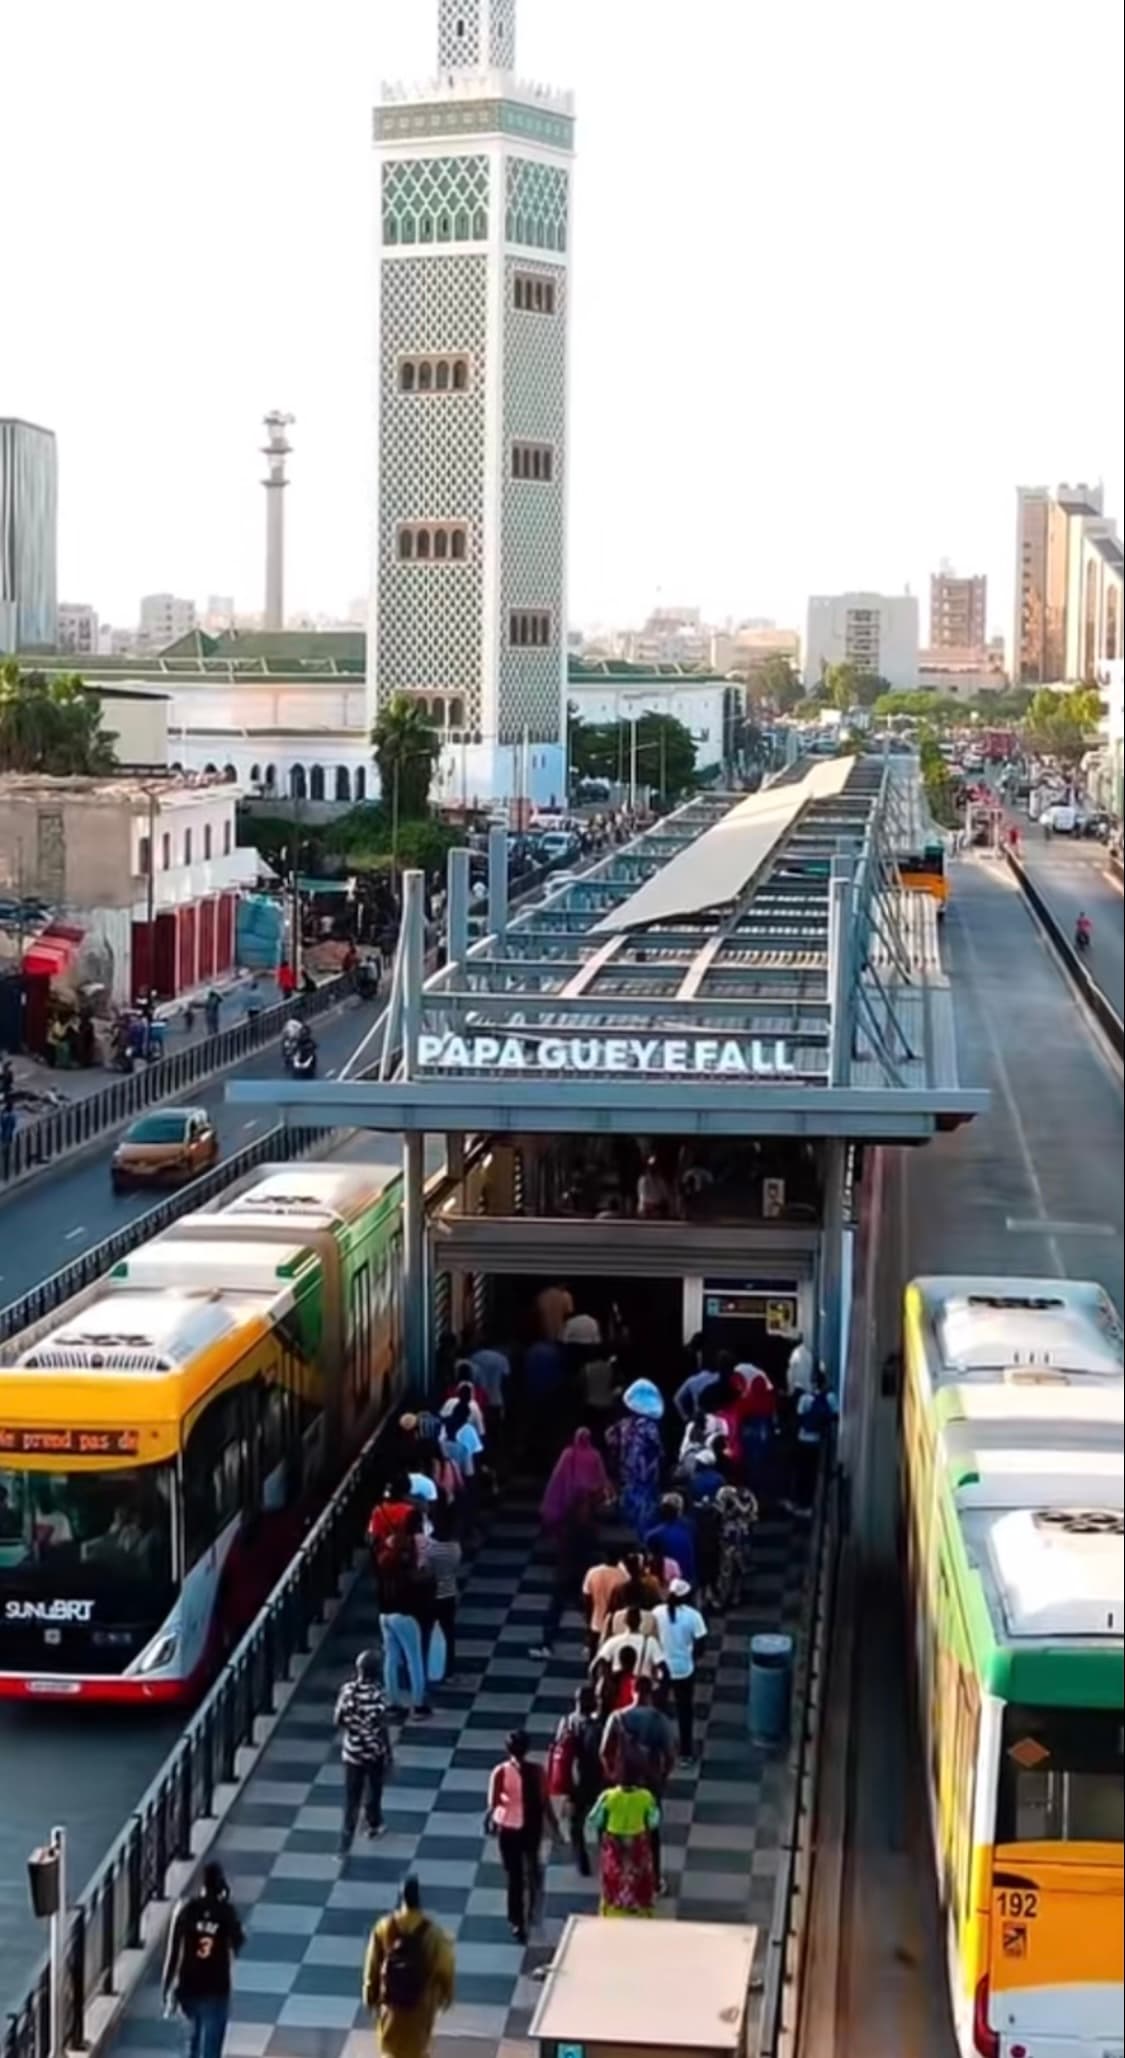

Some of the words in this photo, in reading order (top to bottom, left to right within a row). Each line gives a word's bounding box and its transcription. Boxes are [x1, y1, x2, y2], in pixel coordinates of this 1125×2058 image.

[417, 1034, 526, 1067] PAPA
[537, 1038, 688, 1071] GUEYE
[694, 1040, 796, 1073] FALL
[23, 1430, 72, 1450] prend
[79, 1434, 109, 1451] pas
[997, 1892, 1037, 1918] 192
[197, 1937, 213, 1959] 3
